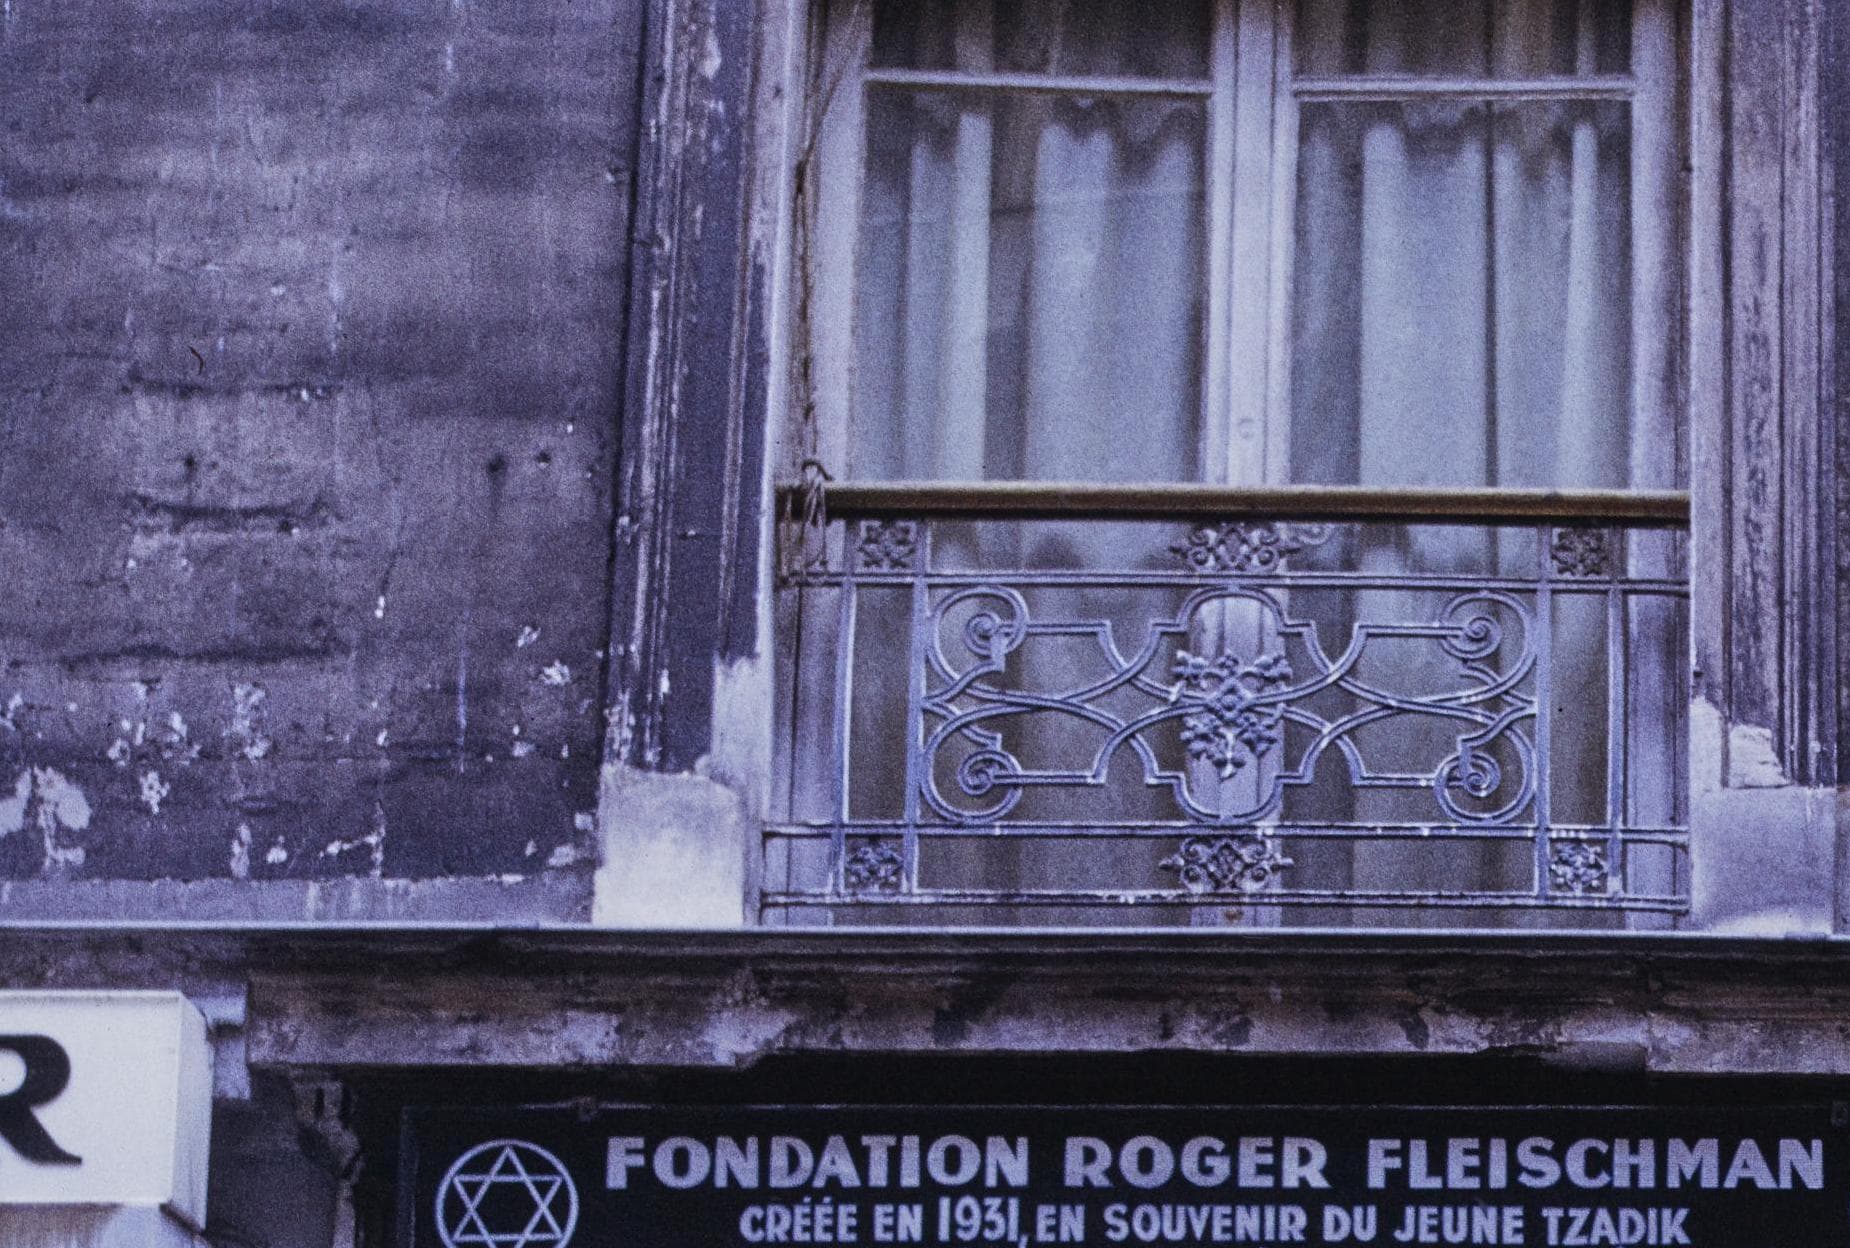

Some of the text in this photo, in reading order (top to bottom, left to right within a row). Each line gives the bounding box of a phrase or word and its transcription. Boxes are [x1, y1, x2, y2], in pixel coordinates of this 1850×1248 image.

[605, 1135, 1824, 1191] FONDATION ROGER FLEISCHMAN
[739, 1196, 857, 1243] CRÉÉE
[873, 1204, 923, 1243] EN
[1035, 1204, 1085, 1243] EN
[1103, 1203, 1307, 1243] SOUVENIR
[1322, 1204, 1377, 1243] DU
[1393, 1205, 1524, 1245] JEUNE
[1541, 1207, 1692, 1246] TZADIK
